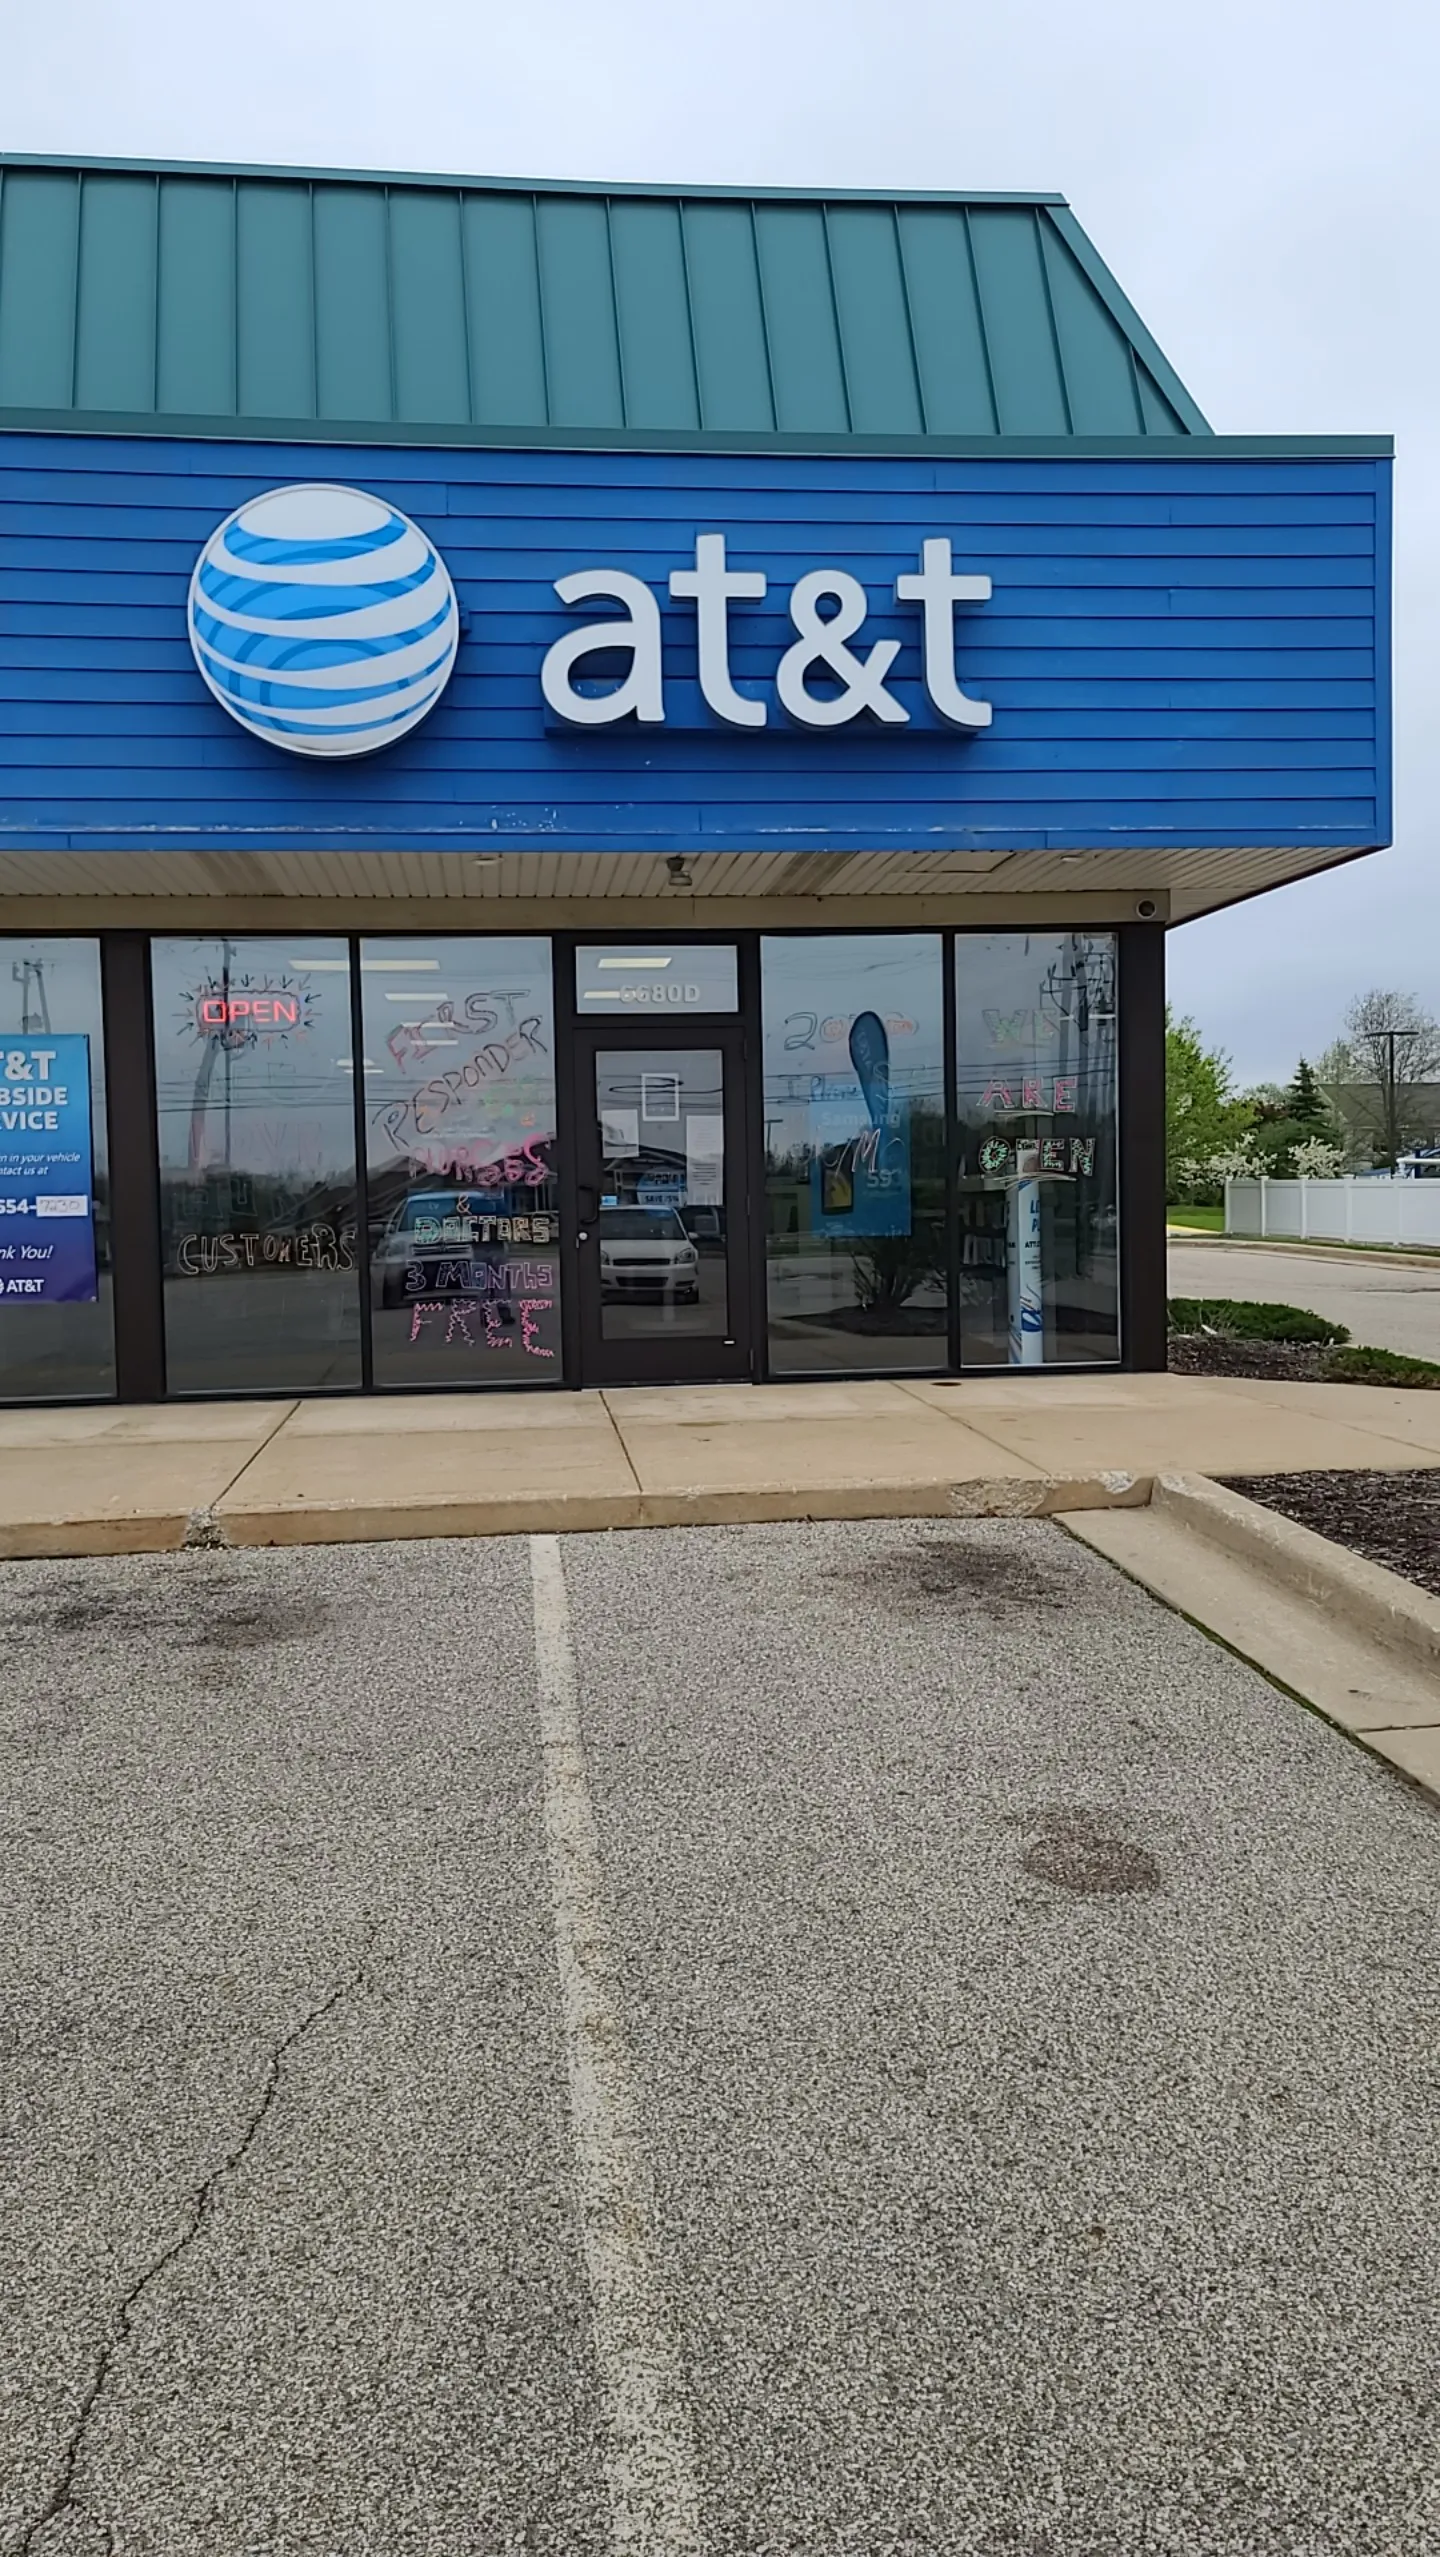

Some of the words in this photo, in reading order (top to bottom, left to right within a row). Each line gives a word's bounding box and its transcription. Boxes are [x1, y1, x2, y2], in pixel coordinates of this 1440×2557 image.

[541, 533, 993, 728] at&t
[620, 985, 700, 1003] 6680D
[203, 1000, 297, 1023] OPEN
[386, 989, 531, 1074] FIRST
[0, 1050, 57, 1081] &T
[0, 1087, 68, 1106] BSIDE
[371, 1014, 548, 1152] RESPONDER
[976, 1076, 1078, 1112] ARE
[0, 1111, 59, 1130] VICE
[20, 1154, 44, 1165] your
[47, 1152, 80, 1162] vehicle
[24, 1167, 36, 1176] us
[37, 1166, 49, 1176] at
[979, 1136, 1096, 1177] OPEN
[456, 1193, 472, 1215] &
[414, 1215, 551, 1245] DOCTORS
[20, 1245, 53, 1259] You!
[178, 1223, 357, 1274] CUSTOMERS
[6, 1279, 44, 1293] AT&T
[405, 1259, 427, 1291] 3
[409, 1298, 555, 1358] FREE
